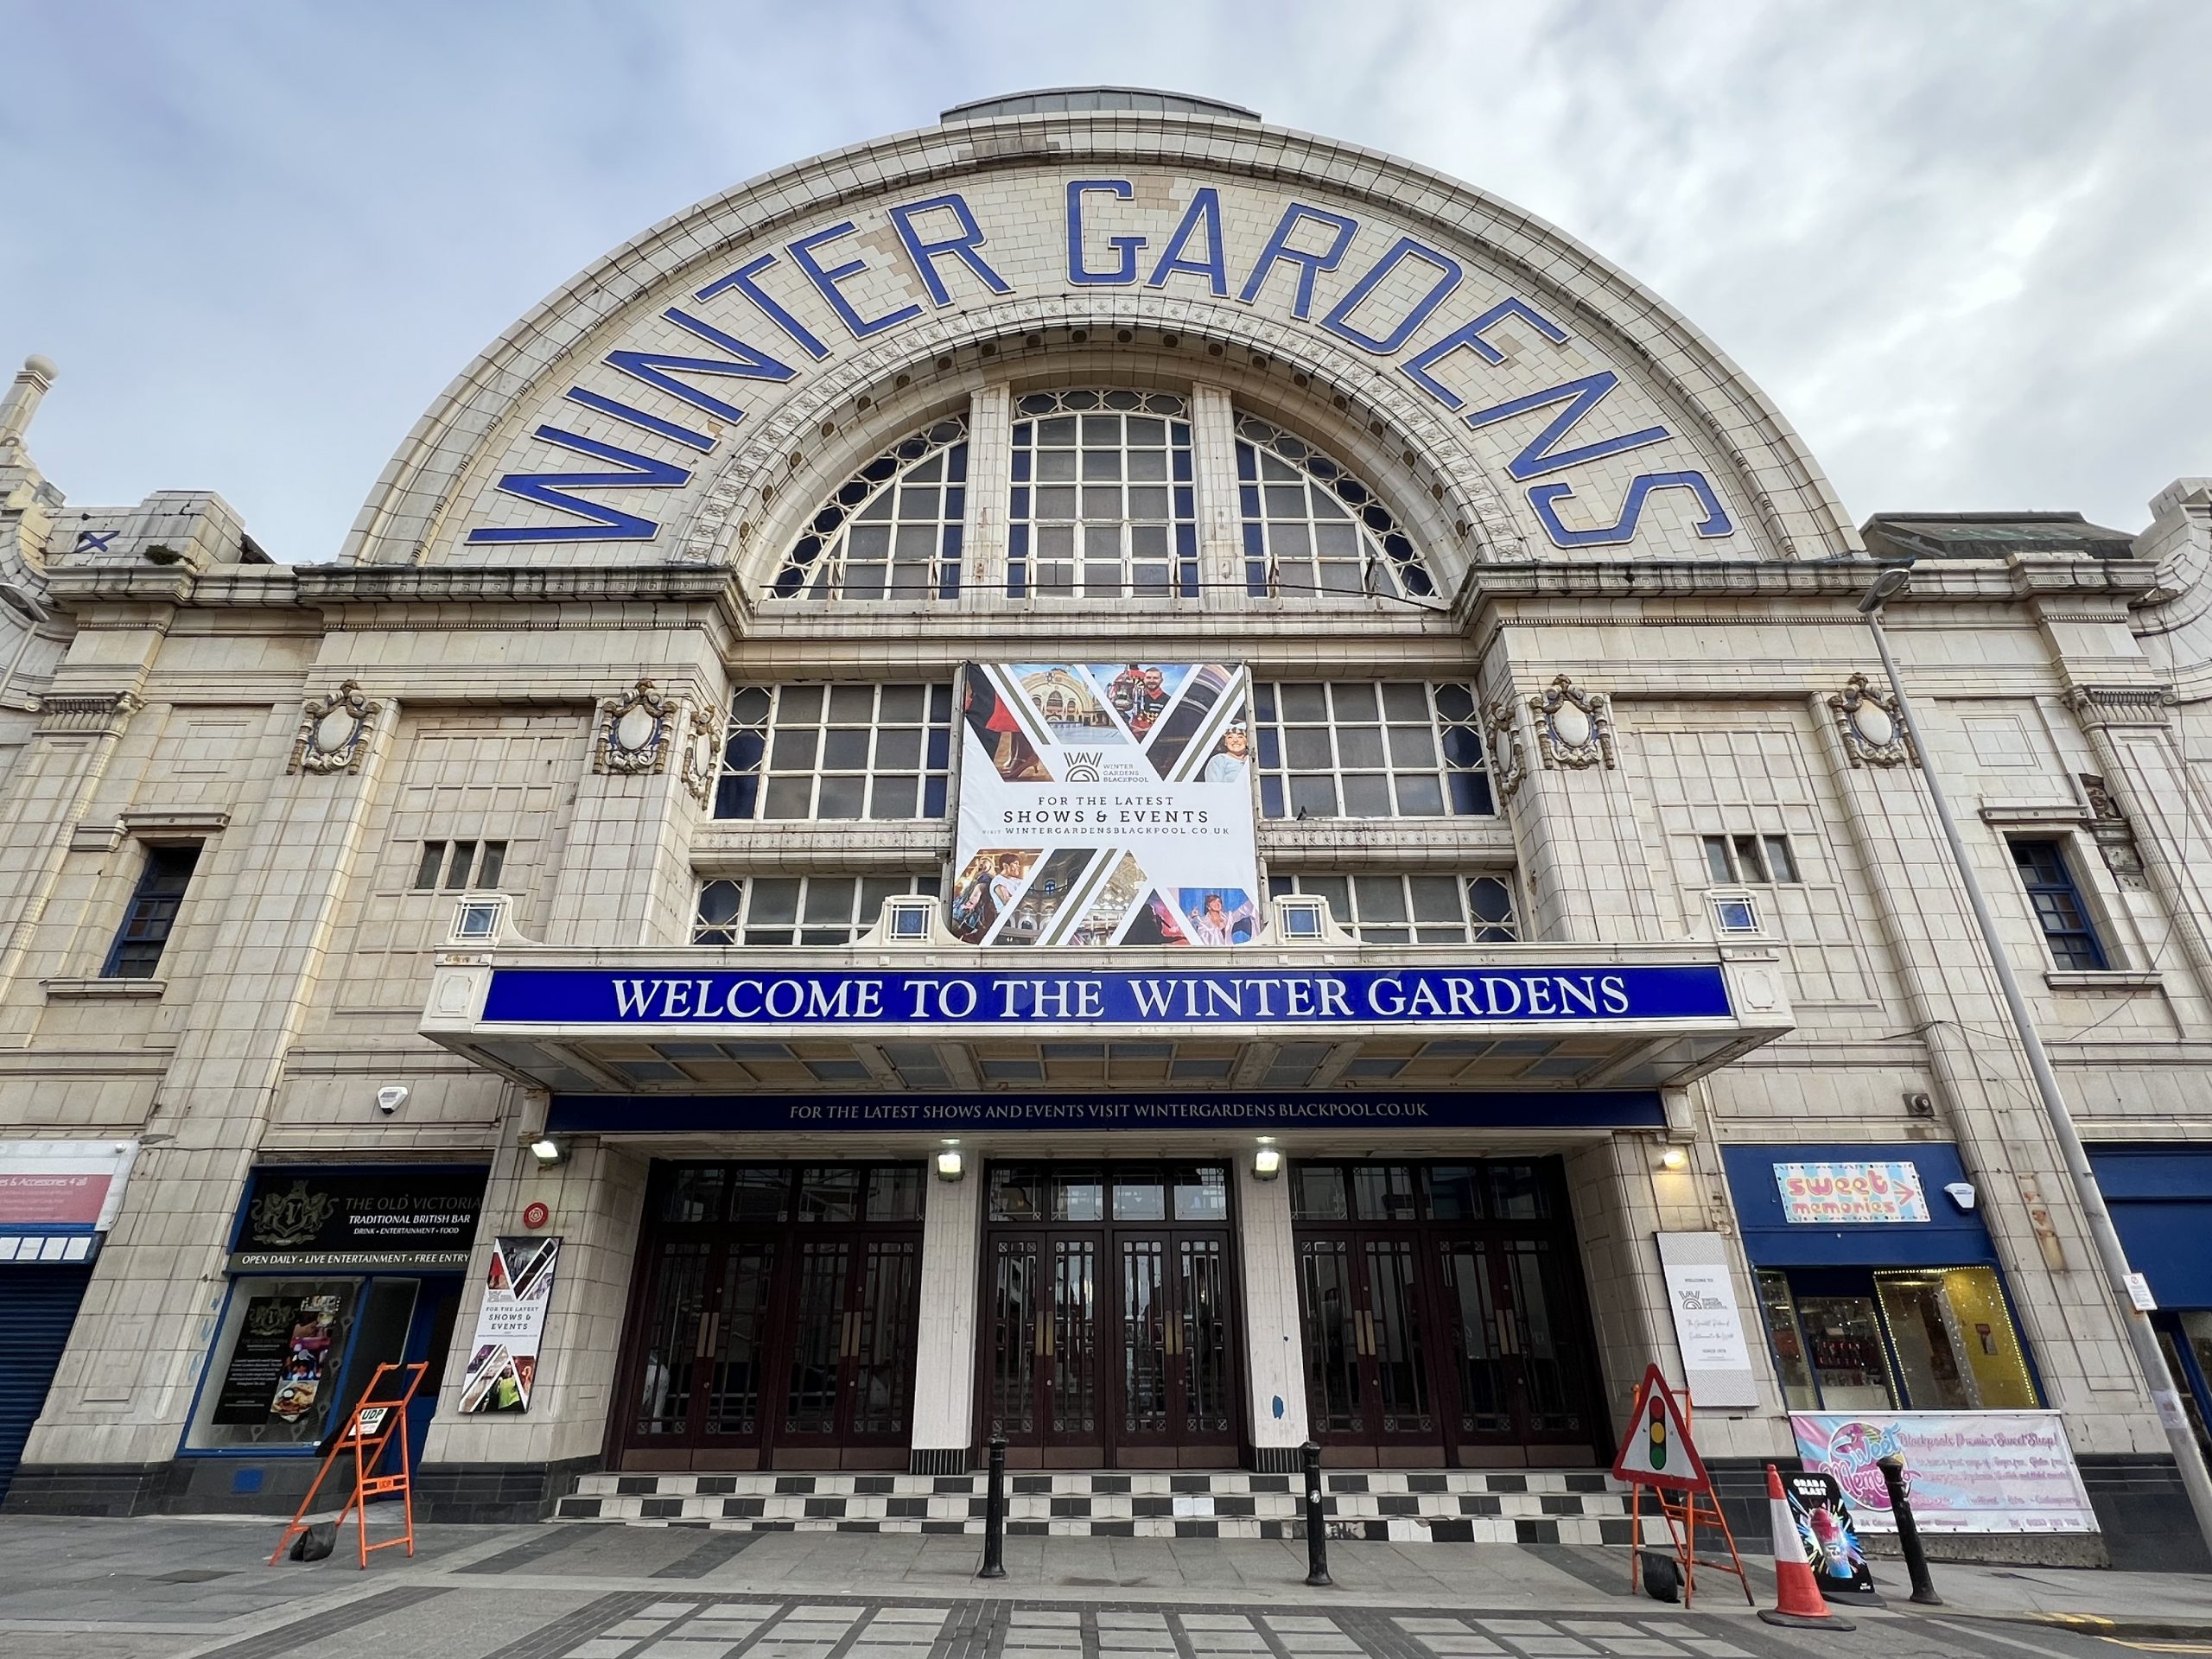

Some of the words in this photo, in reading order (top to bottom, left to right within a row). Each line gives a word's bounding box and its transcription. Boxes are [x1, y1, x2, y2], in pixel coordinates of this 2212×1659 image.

[464, 194, 1015, 545] WINTER
[1066, 180, 1735, 550] GARDENS
[1038, 797, 1068, 806] FOR
[1076, 797, 1107, 806] THE
[1116, 797, 1174, 805] LATEST
[1003, 810, 1085, 823] SHOWS
[1096, 811, 1107, 823] &
[1120, 810, 1209, 823] EVENTS
[612, 979, 884, 1018] WELCOME
[904, 979, 978, 1018] TO
[993, 979, 1105, 1017] THE
[1127, 977, 1355, 1017] WINTER
[1367, 976, 1630, 1015] GARDENS
[790, 1106, 822, 1119] FOR
[826, 1106, 860, 1119] THE
[864, 1105, 919, 1119] LATEST
[923, 1105, 981, 1118] SHOWS
[985, 1105, 1022, 1118] AND
[1026, 1104, 1084, 1118] EVENTS
[1088, 1104, 1130, 1117] VISIT
[1787, 1170, 1888, 1196] sweet
[346, 1198, 374, 1211] THE
[378, 1197, 409, 1211] OLD
[1792, 1196, 1896, 1214] memories
[349, 1215, 410, 1224] TRADITIONAL
[413, 1215, 450, 1224] BRITISH
[451, 1214, 471, 1224] BAR
[242, 1255, 266, 1265] OPEN
[270, 1255, 298, 1264] DAILY
[305, 1255, 325, 1264] LIVE
[327, 1254, 406, 1263] ENTERTAINMENT
[414, 1254, 437, 1263] FREE
[439, 1253, 471, 1262] ENTRY
[361, 1409, 385, 1420] UDP
